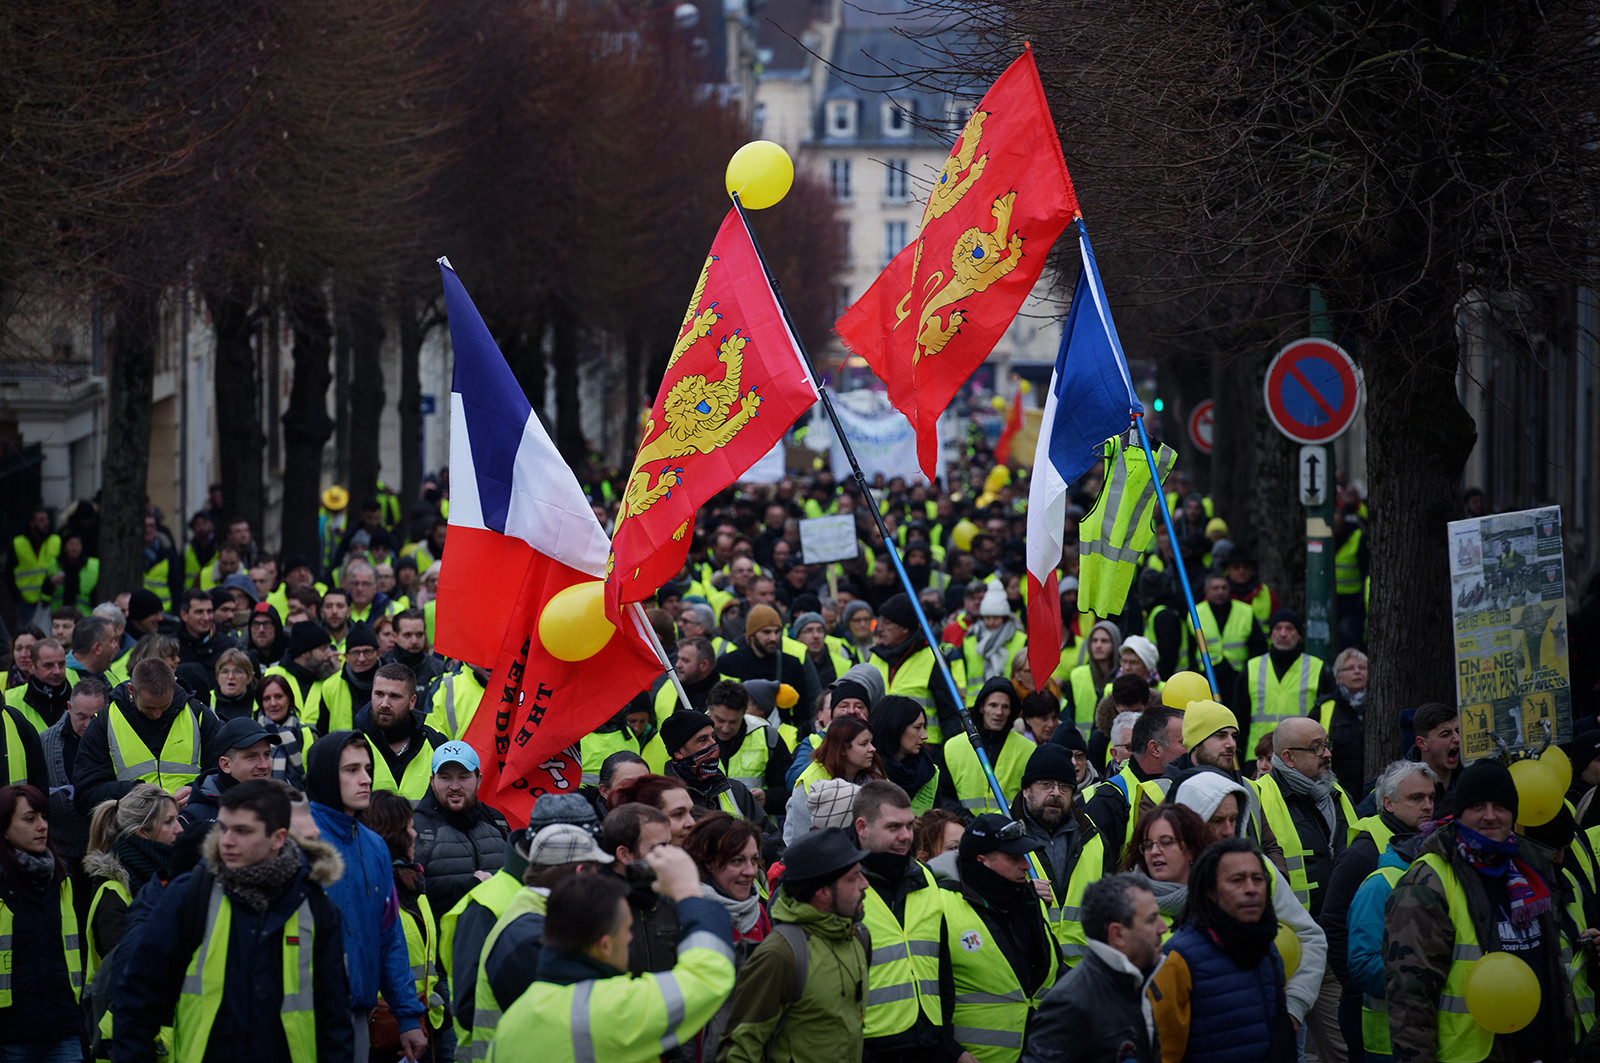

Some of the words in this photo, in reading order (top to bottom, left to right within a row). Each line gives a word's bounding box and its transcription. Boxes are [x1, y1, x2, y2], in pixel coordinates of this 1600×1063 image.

[1459, 657, 1480, 676] ON
[1535, 669, 1560, 680] FORCE
[1534, 678, 1554, 692] AVEC
[443, 745, 462, 755] NY
